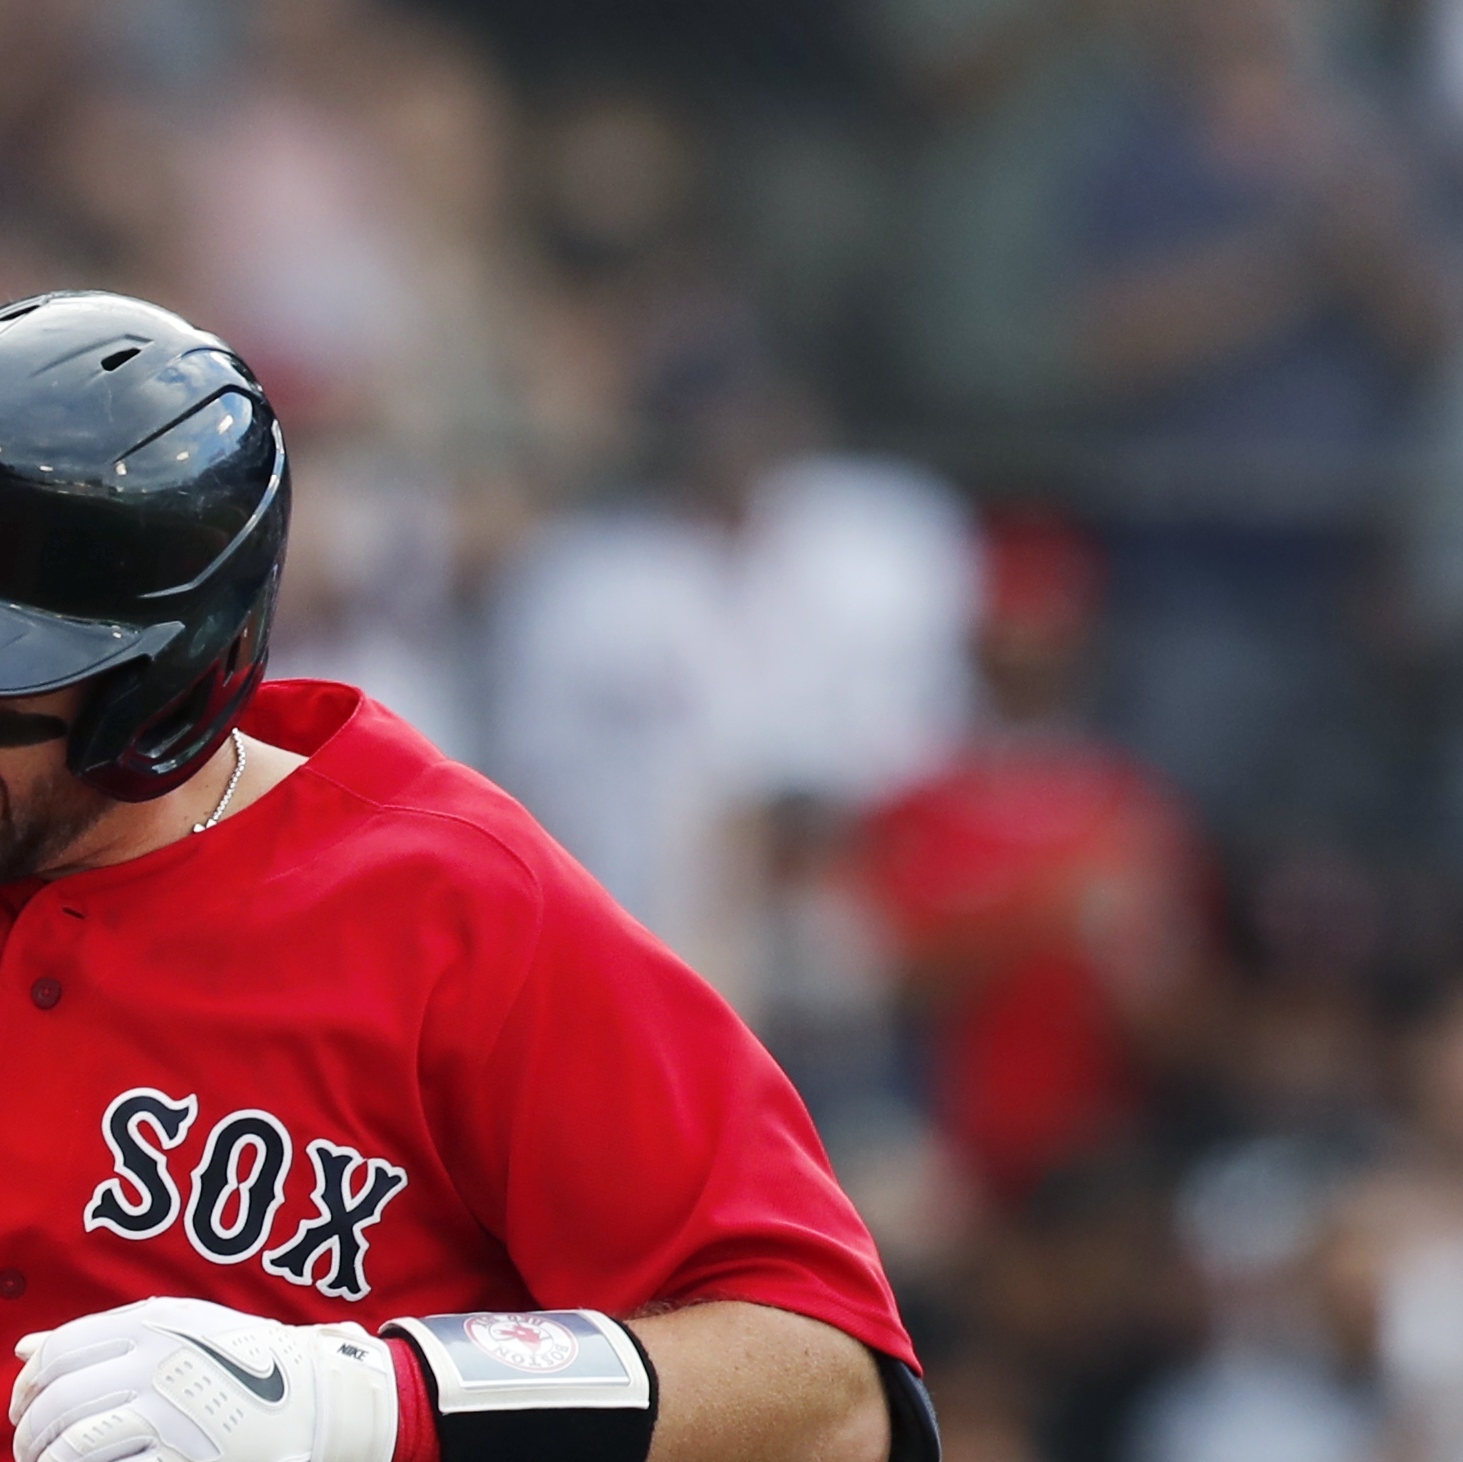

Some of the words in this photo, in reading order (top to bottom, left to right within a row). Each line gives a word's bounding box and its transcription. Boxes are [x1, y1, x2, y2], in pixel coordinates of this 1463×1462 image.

[83, 1086, 407, 1302] SOX
[336, 1342, 369, 1362] NIKE
[493, 1343, 569, 1368] BOSTON
